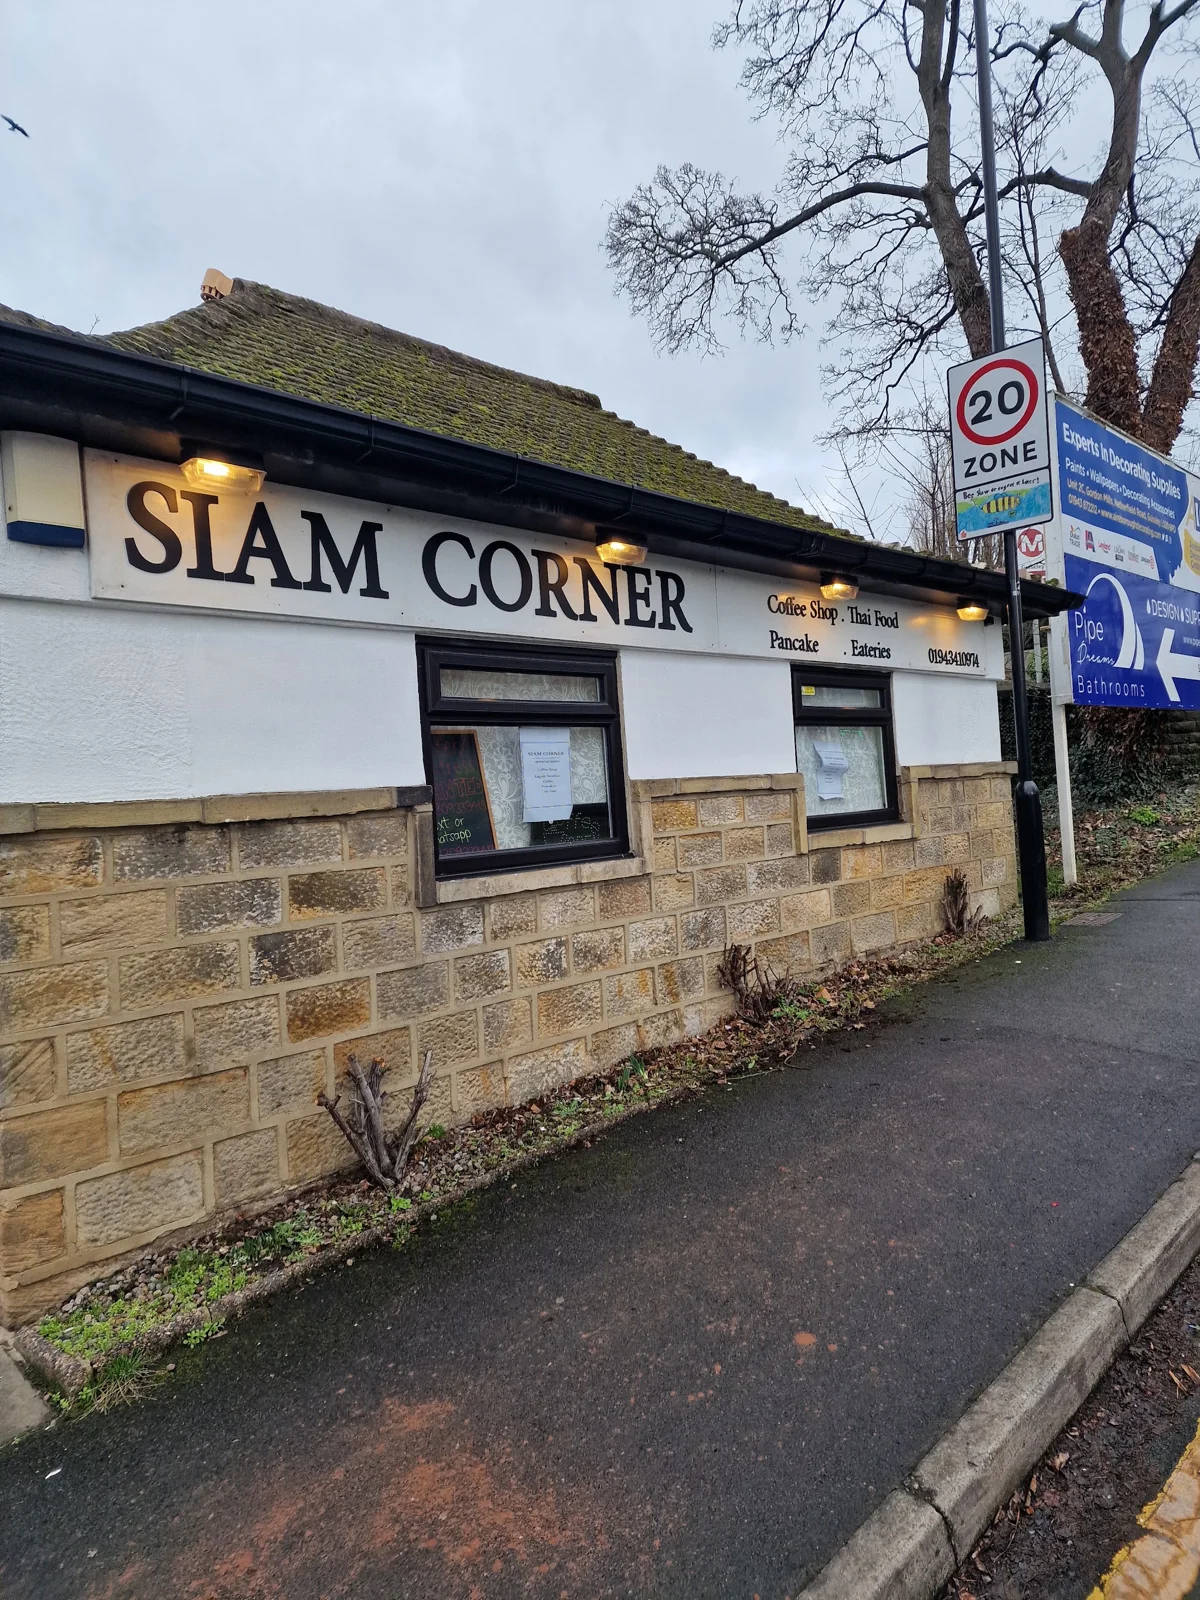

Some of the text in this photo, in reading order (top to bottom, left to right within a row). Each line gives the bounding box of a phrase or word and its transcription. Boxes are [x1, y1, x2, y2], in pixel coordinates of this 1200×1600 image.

[968, 380, 1025, 426] 20
[963, 440, 1038, 478] ZONE
[1062, 422, 1100, 458] Experts
[1110, 448, 1151, 488] Decorating
[1151, 470, 1181, 500] Supplies
[1065, 457, 1086, 477] Paints
[1089, 467, 1120, 493] Wallpapers
[1122, 484, 1151, 508] Decorating
[124, 481, 694, 634] SIAM CORNER
[767, 594, 900, 629] Coffee Shop Thai Food
[1074, 608, 1104, 644] Pipe
[1151, 598, 1200, 625] DESIGN SUPP
[768, 630, 891, 660] Pancake Eateries
[928, 647, 980, 668] 01943410974
[1077, 640, 1116, 666] Dreams
[1077, 675, 1145, 697] Bathrooms
[437, 816, 464, 831] xt or
[437, 829, 472, 844] atsapp
